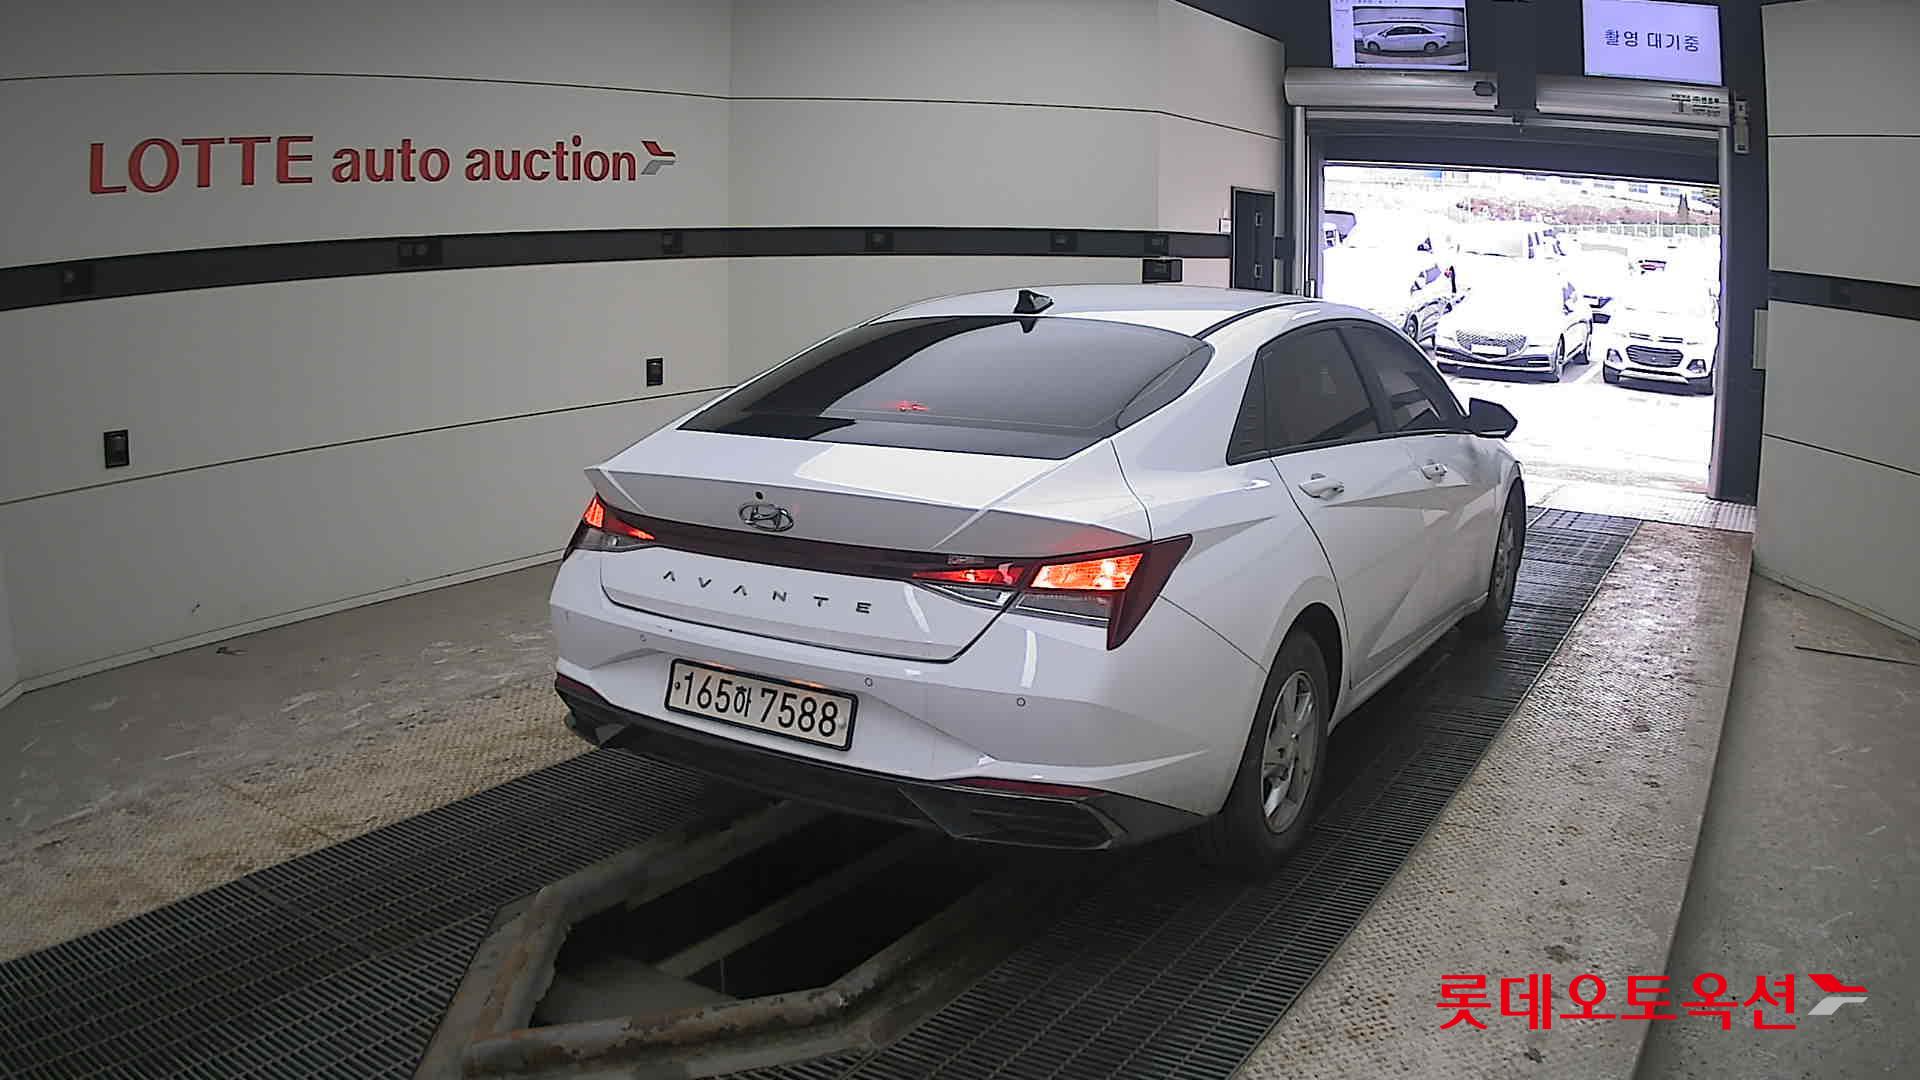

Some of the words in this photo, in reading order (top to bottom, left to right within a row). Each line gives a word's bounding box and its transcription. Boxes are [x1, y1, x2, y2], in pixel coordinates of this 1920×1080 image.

[1647, 32, 1699, 52] 대기중
[89, 136, 314, 194] LOTTE
[331, 138, 451, 183] auto
[464, 135, 637, 182] auction
[663, 570, 872, 614] AVANTE
[684, 671, 752, 718] 165하
[760, 687, 839, 738] 7588
